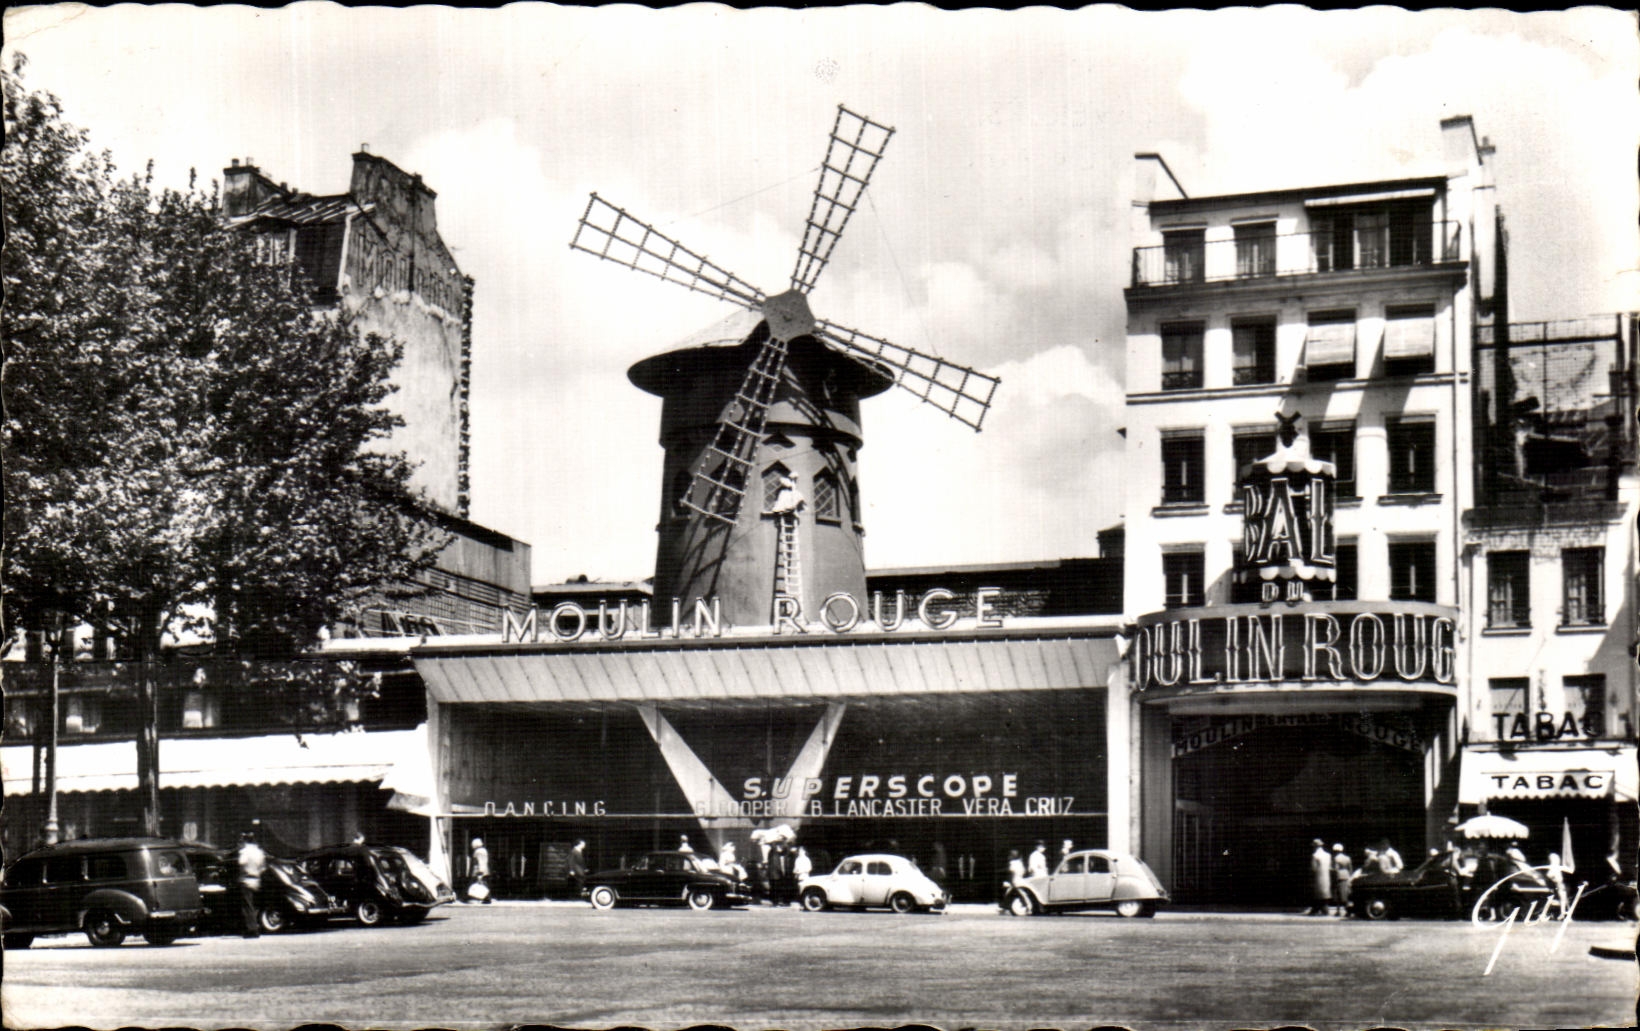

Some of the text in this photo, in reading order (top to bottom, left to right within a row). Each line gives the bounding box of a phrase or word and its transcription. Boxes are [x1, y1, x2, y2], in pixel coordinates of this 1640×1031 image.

[1243, 477, 1335, 564] BAL
[1261, 581, 1304, 602] DU
[501, 586, 1004, 642] MOULIN ROUGE
[1491, 711, 1602, 740] TABAC
[1491, 775, 1603, 790] TABAC
[484, 800, 606, 817] DANCING
[835, 798, 942, 817] LANCASTER
[963, 798, 1013, 817] VERA
[1025, 797, 1075, 817] CRUZ
